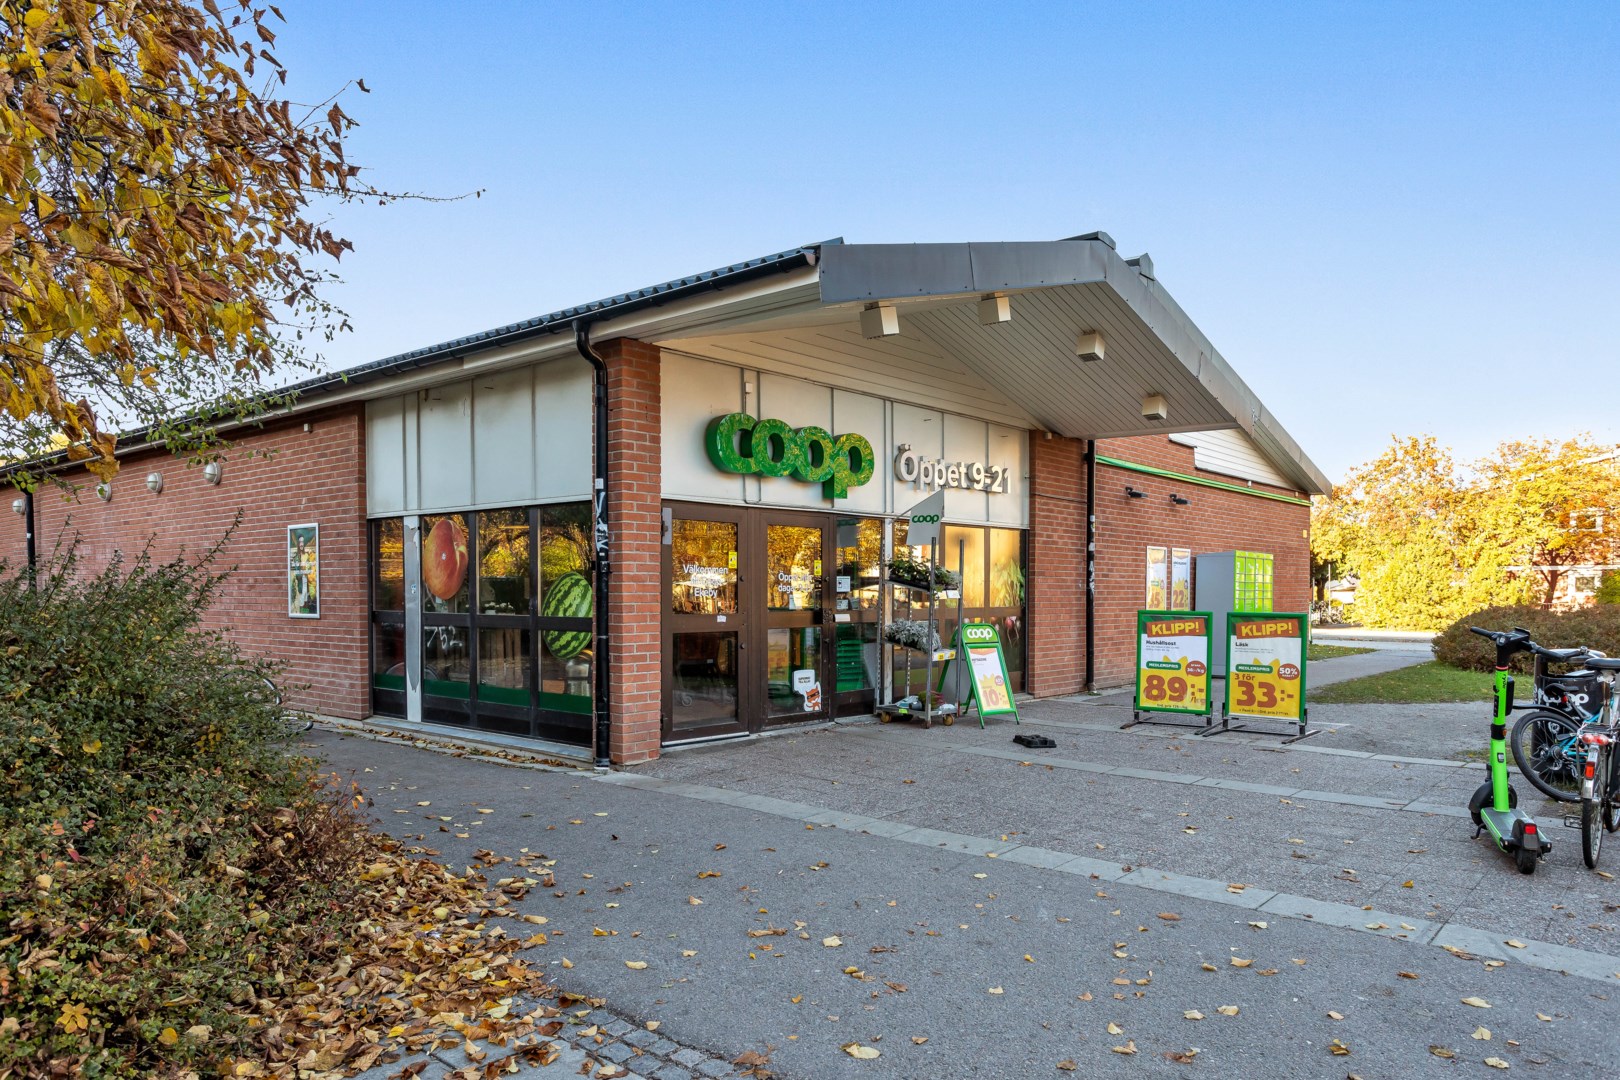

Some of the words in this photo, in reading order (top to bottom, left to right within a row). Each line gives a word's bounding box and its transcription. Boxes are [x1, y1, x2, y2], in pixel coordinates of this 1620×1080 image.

[706, 413, 875, 499] coop
[895, 444, 967, 491] Öppet
[969, 462, 1011, 494] 9-21
[912, 514, 940, 524] coop
[682, 563, 728, 574] Välkommen
[694, 588, 718, 599] Ekeby
[966, 628, 993, 641] coop
[1151, 621, 1199, 635] KLIPP!
[1241, 622, 1292, 637] KLIPP!
[1279, 667, 1298, 675] 50%
